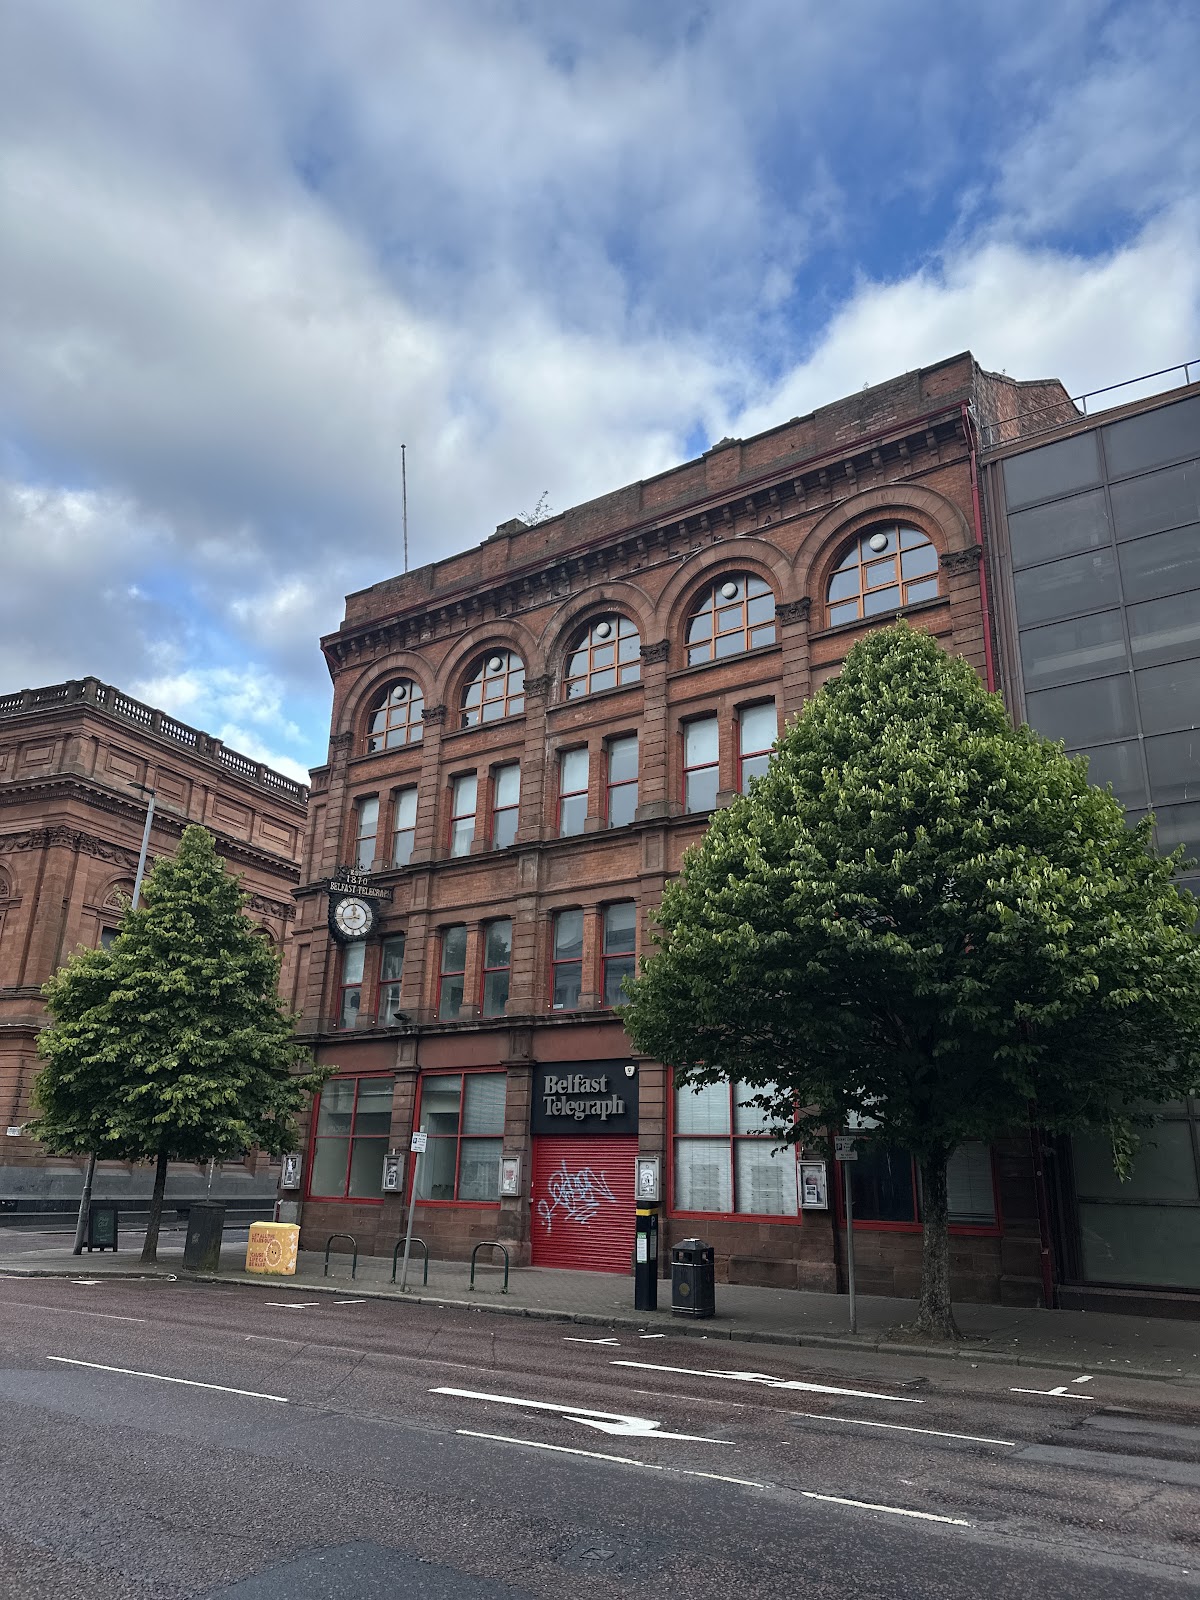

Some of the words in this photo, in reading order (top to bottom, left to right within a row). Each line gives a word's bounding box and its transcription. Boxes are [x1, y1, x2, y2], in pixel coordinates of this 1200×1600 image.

[347, 875, 368, 885] 1870
[330, 881, 357, 894] BELFAST
[358, 886, 392, 898] TELEGRAPH
[543, 1074, 608, 1094] Belfast
[543, 1094, 625, 1121] Telegraph
